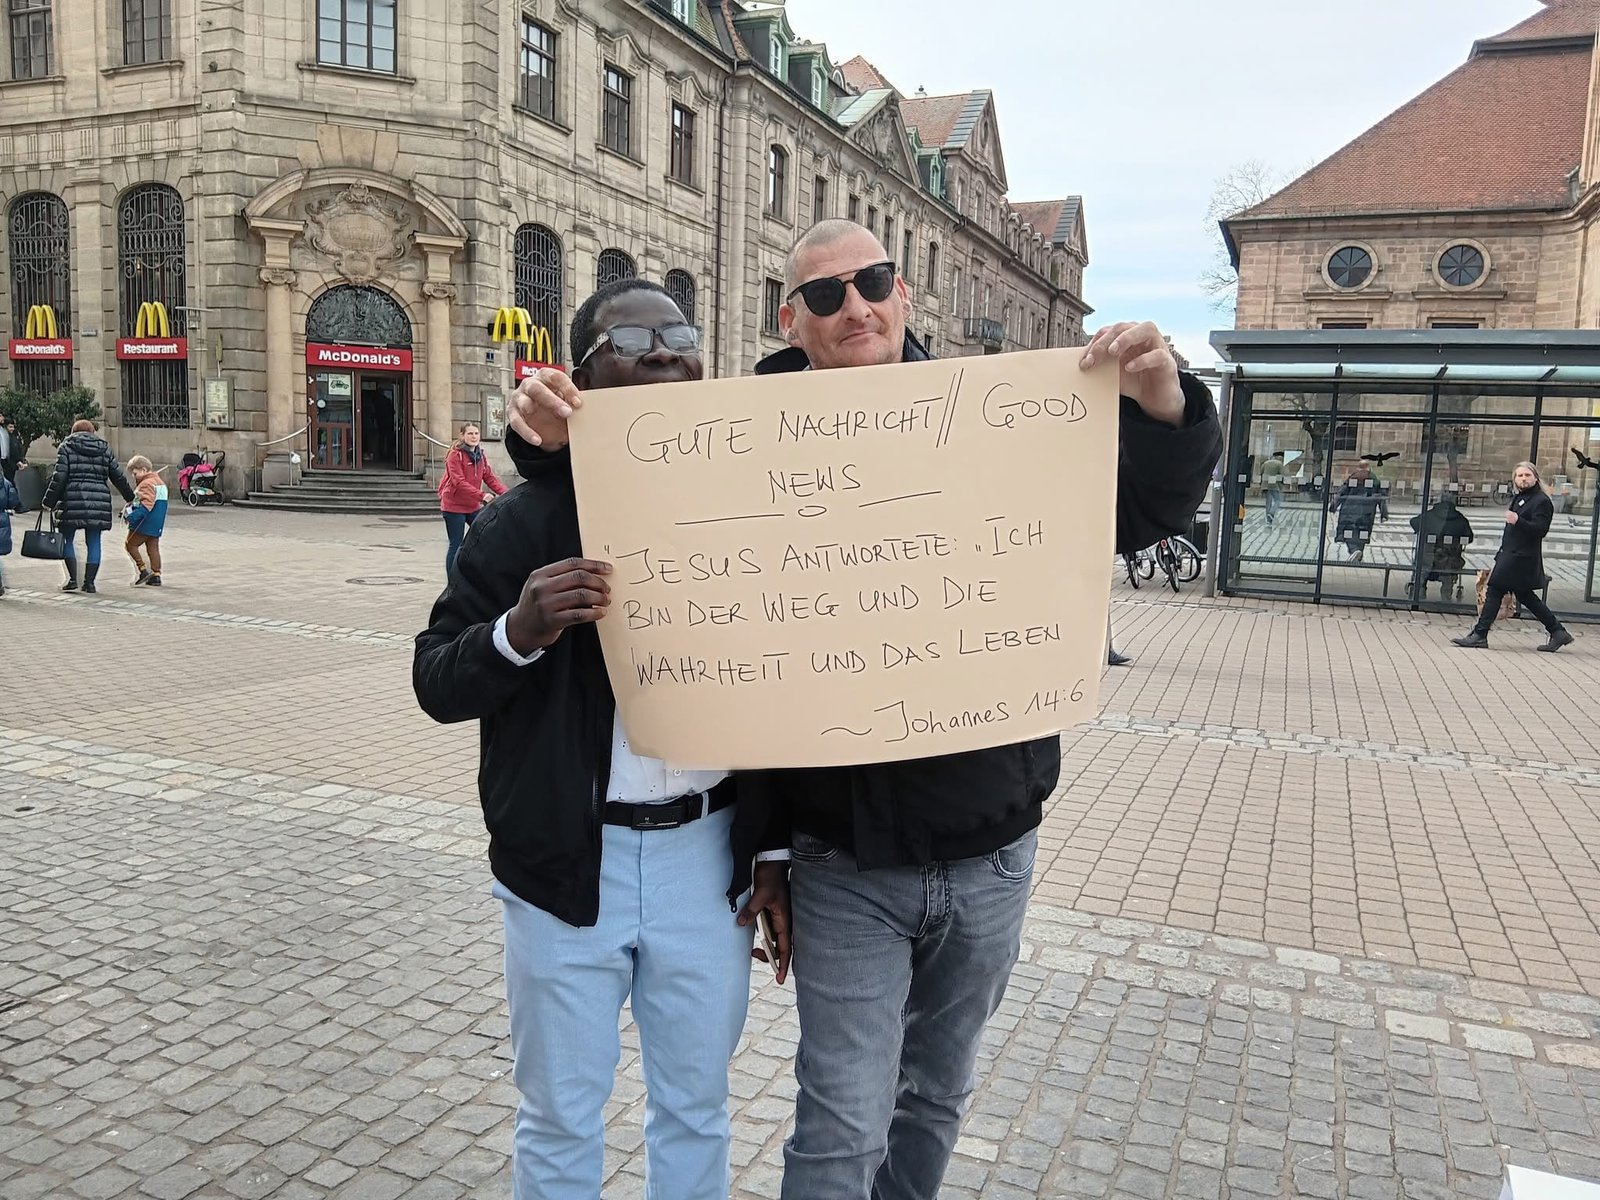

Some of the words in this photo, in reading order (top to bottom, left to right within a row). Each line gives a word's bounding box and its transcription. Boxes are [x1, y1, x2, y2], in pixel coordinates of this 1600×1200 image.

[15, 344, 66, 355] McDonald's
[123, 343, 178, 355] Restaurant
[318, 349, 401, 365] McDonald's
[627, 412, 753, 464] GUTE
[982, 383, 1088, 429] GOOD
[768, 464, 862, 504] NEWS
[781, 534, 958, 573] ANTWORTETE:
[623, 600, 672, 631] BIN
[686, 600, 749, 627] DER
[762, 592, 839, 622] WEG
[859, 585, 920, 612] UND
[943, 577, 997, 610] DIE
[631, 647, 791, 686] WAHRHEIT
[811, 650, 866, 674] UND
[882, 641, 941, 670] DAS
[958, 624, 1061, 655] LEBEN
[873, 700, 1010, 743] Johannes
[1025, 679, 1085, 716] 14:6
